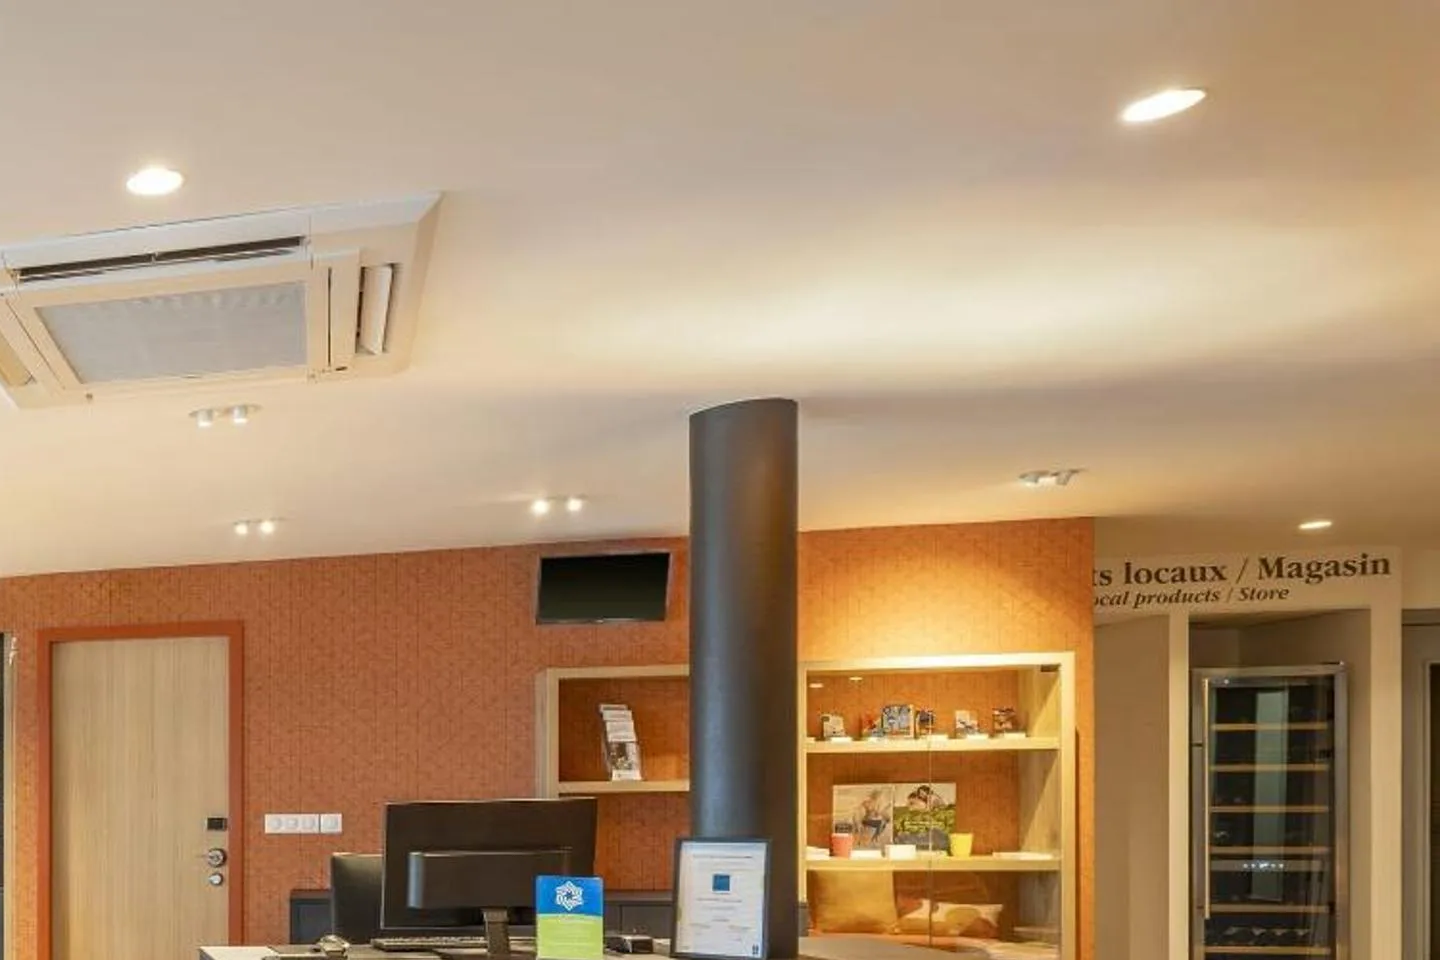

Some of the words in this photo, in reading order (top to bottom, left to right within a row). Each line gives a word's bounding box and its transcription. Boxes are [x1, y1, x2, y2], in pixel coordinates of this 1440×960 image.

[1124, 561, 1227, 585] locaux
[1234, 557, 1249, 585] /
[1258, 553, 1392, 585] Magasin
[1132, 588, 1221, 609] products
[1238, 586, 1290, 602] Store
